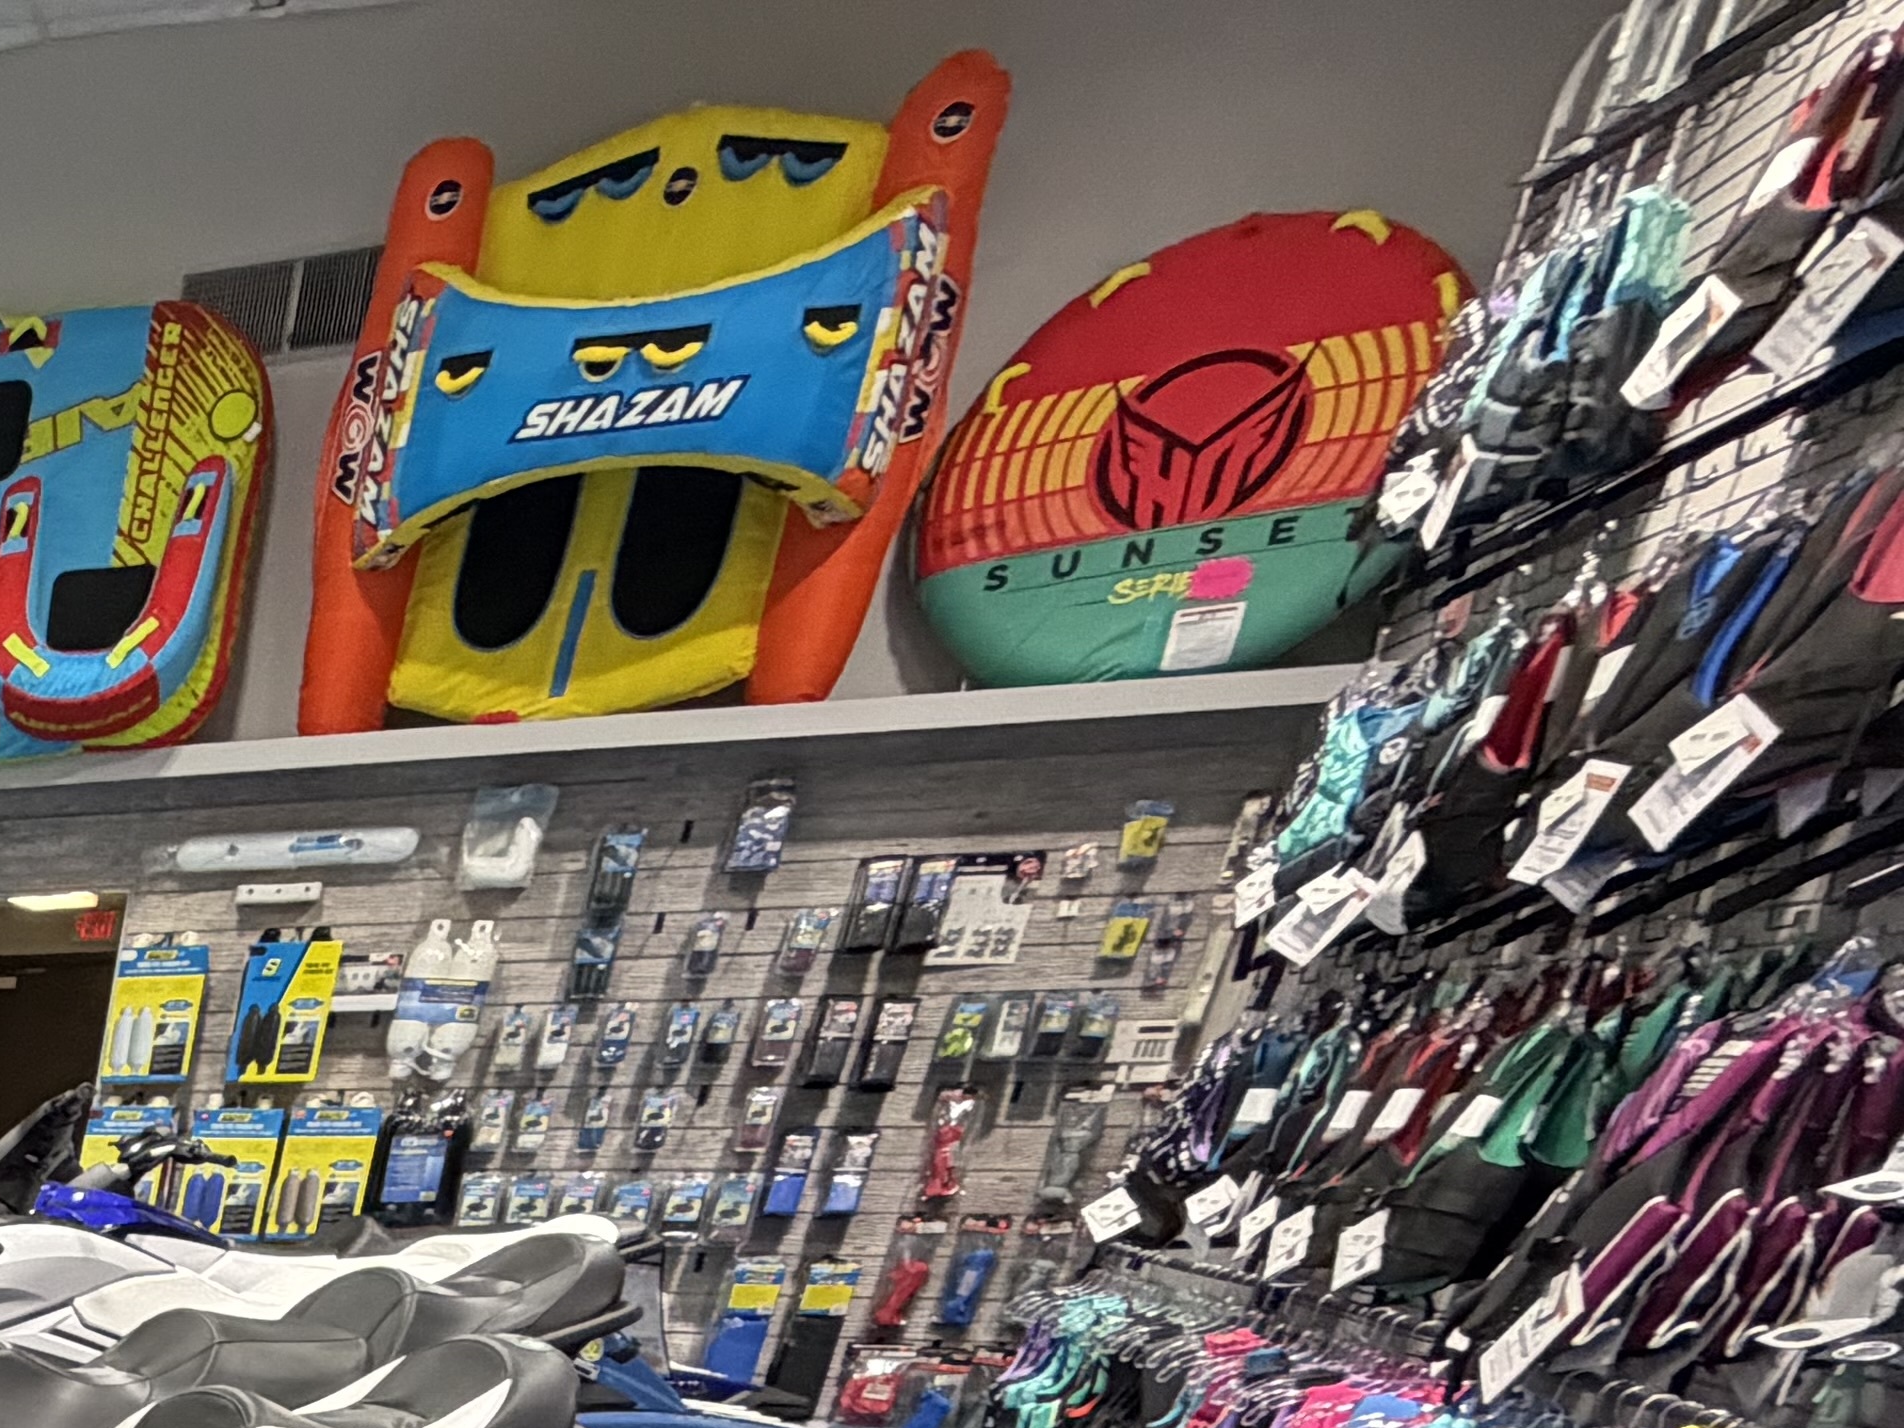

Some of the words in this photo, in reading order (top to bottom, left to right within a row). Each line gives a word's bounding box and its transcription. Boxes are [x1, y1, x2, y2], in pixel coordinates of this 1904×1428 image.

[128, 320, 181, 544] CHALLENGER
[521, 379, 744, 439] SHAZAM
[1108, 570, 1193, 605] SERIE
